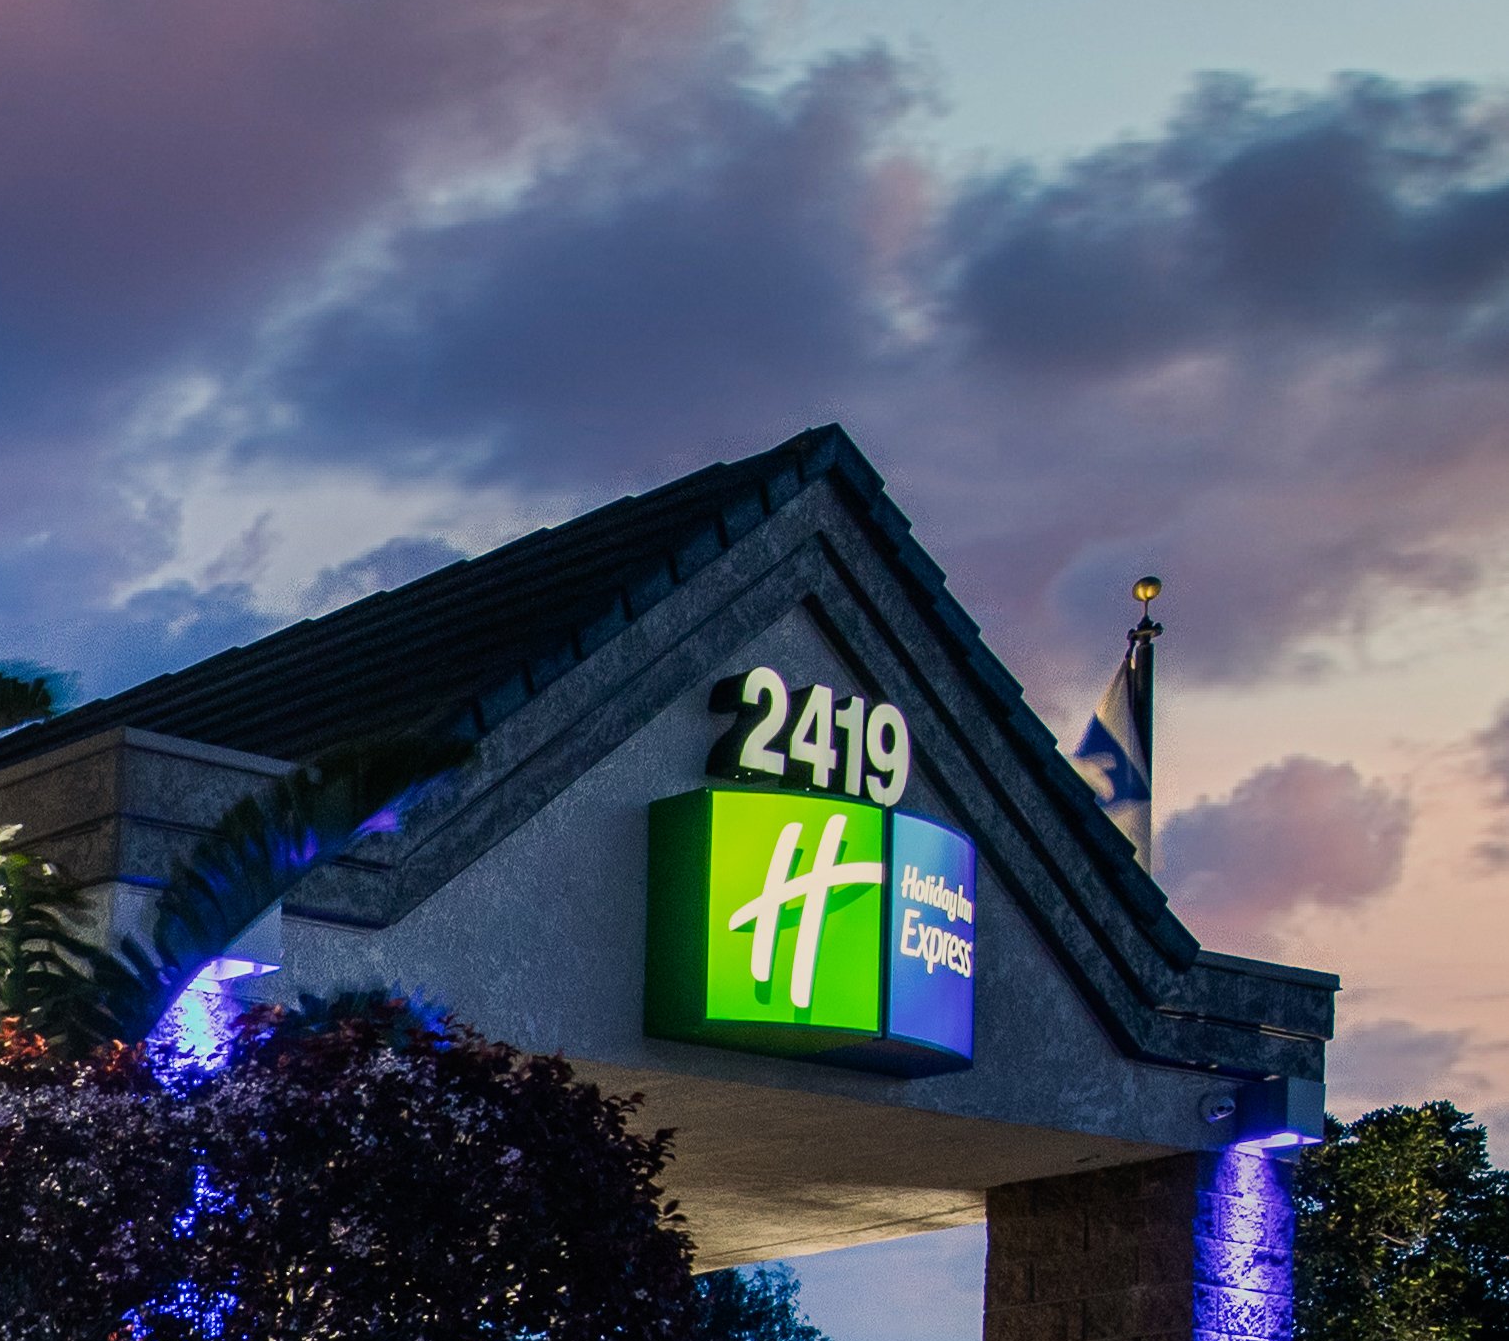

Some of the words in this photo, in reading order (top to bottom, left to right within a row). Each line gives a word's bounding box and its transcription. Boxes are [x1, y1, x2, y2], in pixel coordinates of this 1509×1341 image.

[739, 666, 911, 806] 2419
[729, 813, 883, 1009] H
[900, 864, 957, 922] Holiday
[956, 884, 973, 925] Inn
[900, 908, 972, 978] Express
